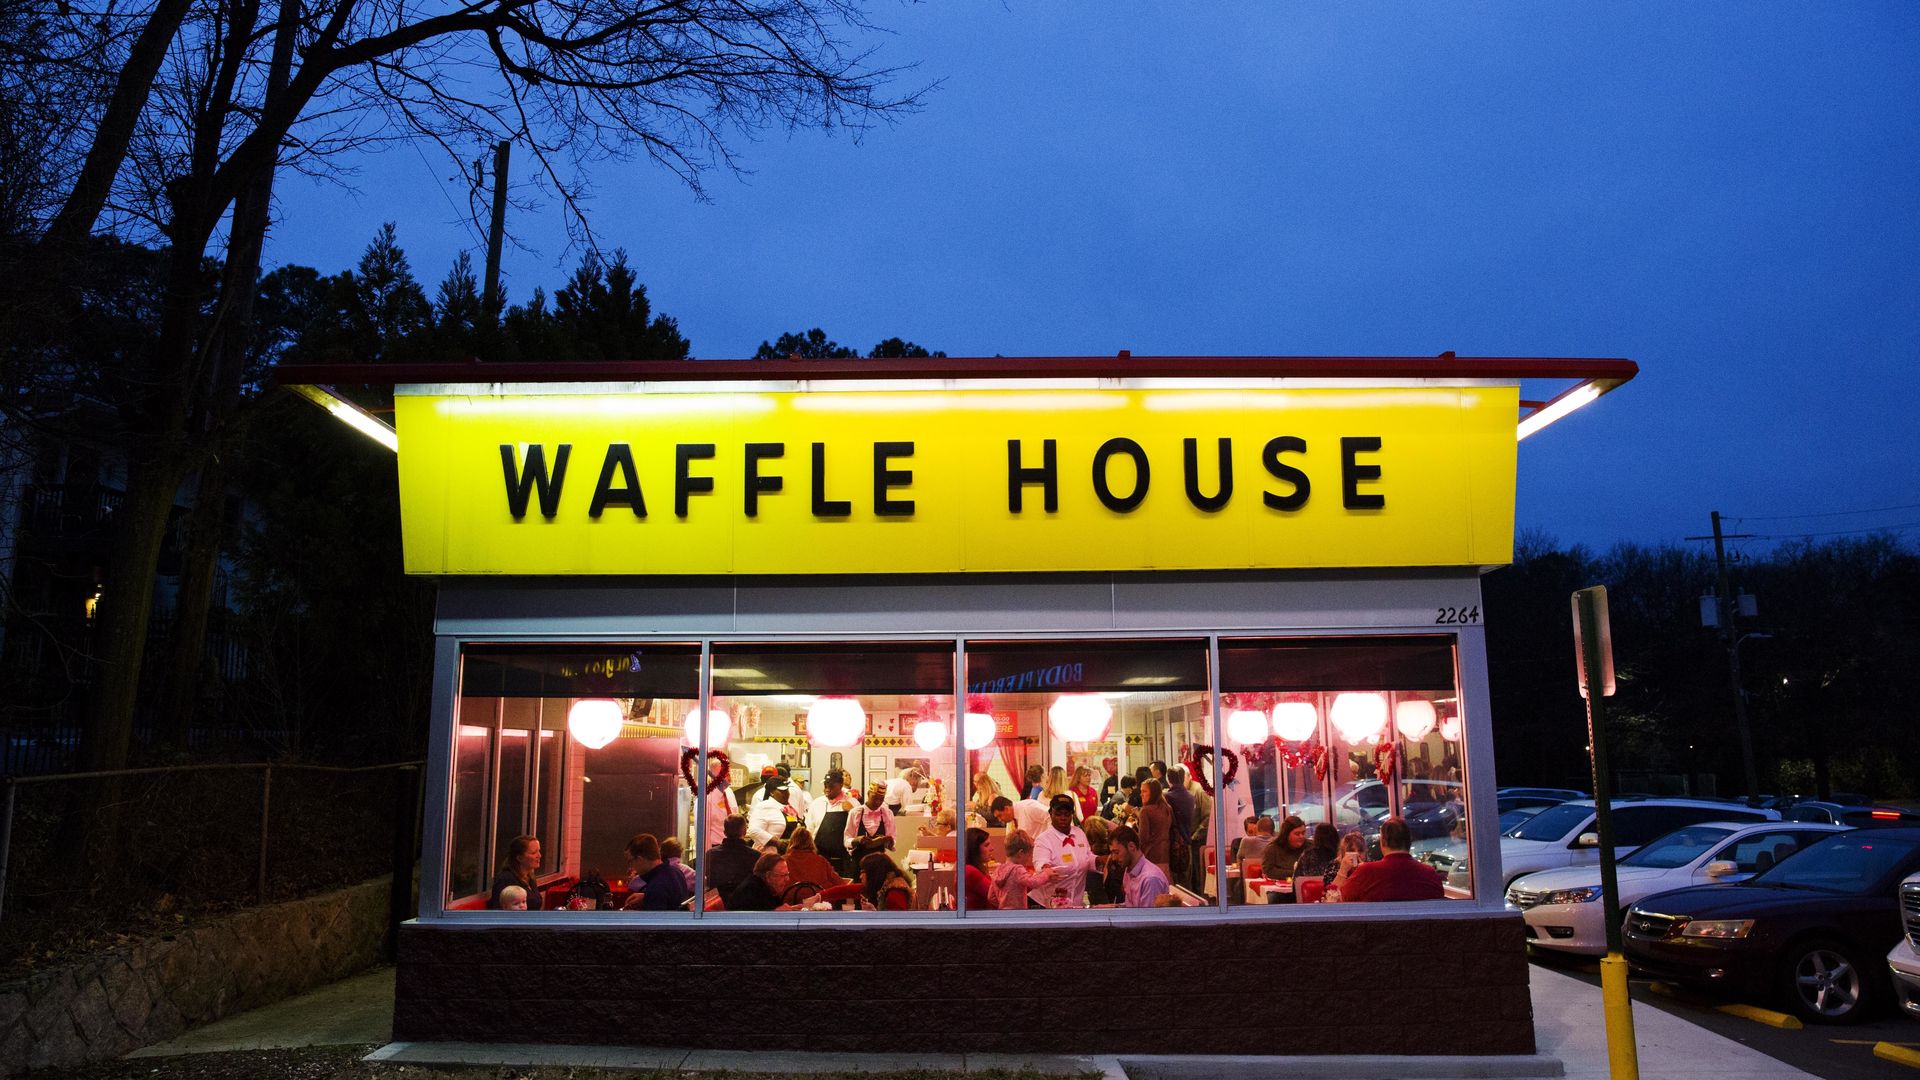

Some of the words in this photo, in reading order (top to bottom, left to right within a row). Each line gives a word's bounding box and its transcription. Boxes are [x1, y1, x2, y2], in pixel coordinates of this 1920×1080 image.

[500, 441, 915, 518] WAFFLE
[1007, 436, 1385, 514] HOUSE
[1435, 605, 1479, 624] 2264
